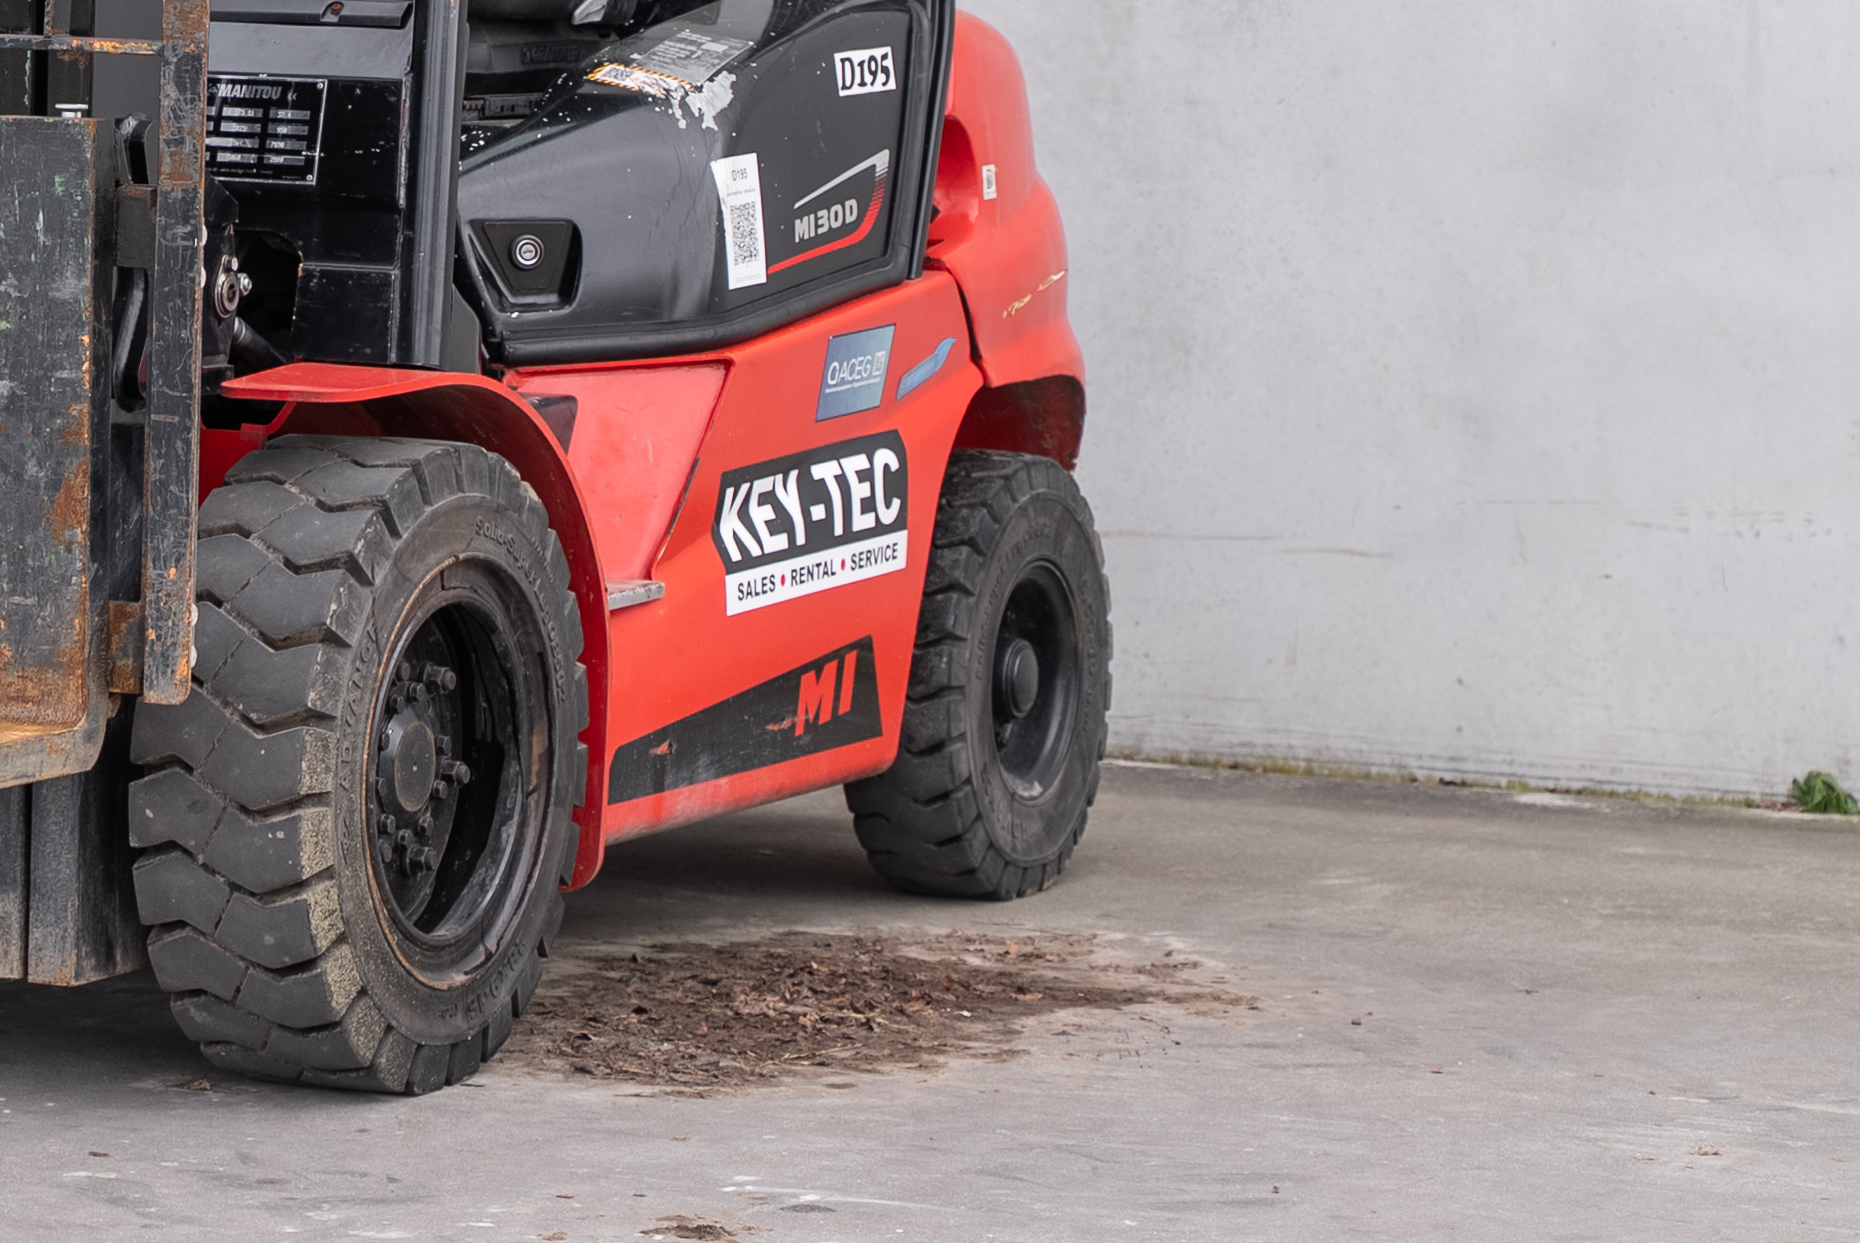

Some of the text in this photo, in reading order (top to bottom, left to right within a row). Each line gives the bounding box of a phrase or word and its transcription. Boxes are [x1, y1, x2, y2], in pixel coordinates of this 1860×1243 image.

[218, 83, 283, 100] MANITOU
[839, 52, 891, 91] D195
[731, 168, 749, 182] D195
[719, 447, 901, 563] KEY-TEC
[737, 542, 899, 601] SALES RENTAL SERVICE
[794, 648, 858, 737] MI
